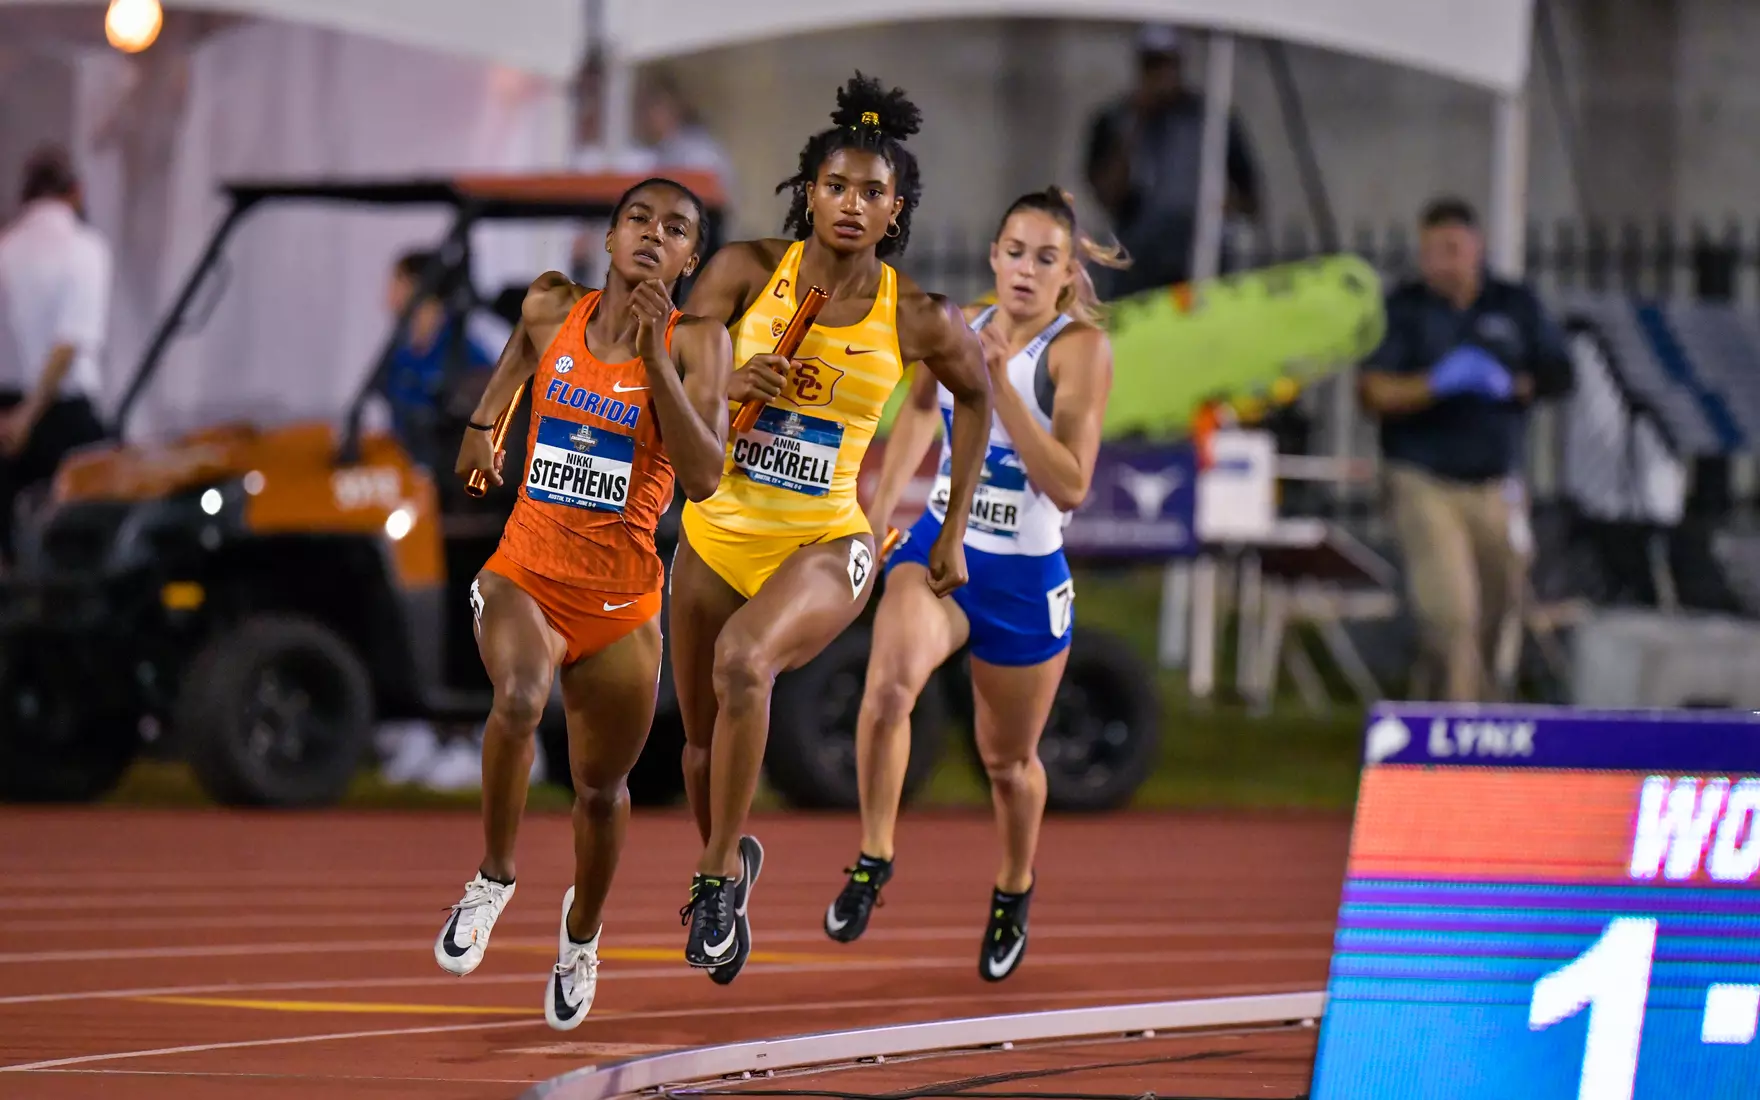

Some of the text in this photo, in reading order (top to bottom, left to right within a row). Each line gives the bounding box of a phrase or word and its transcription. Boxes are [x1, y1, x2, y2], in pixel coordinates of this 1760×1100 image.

[555, 356, 574, 374] SEC
[545, 378, 641, 430] FLORIDA
[566, 452, 593, 469] NIKKI
[733, 438, 830, 485] COCKRELL
[772, 437, 800, 452] ANNA
[530, 458, 627, 502] STEPHENS
[853, 549, 870, 587] 6
[1056, 587, 1069, 631] 7
[1428, 720, 1536, 757] LYNX
